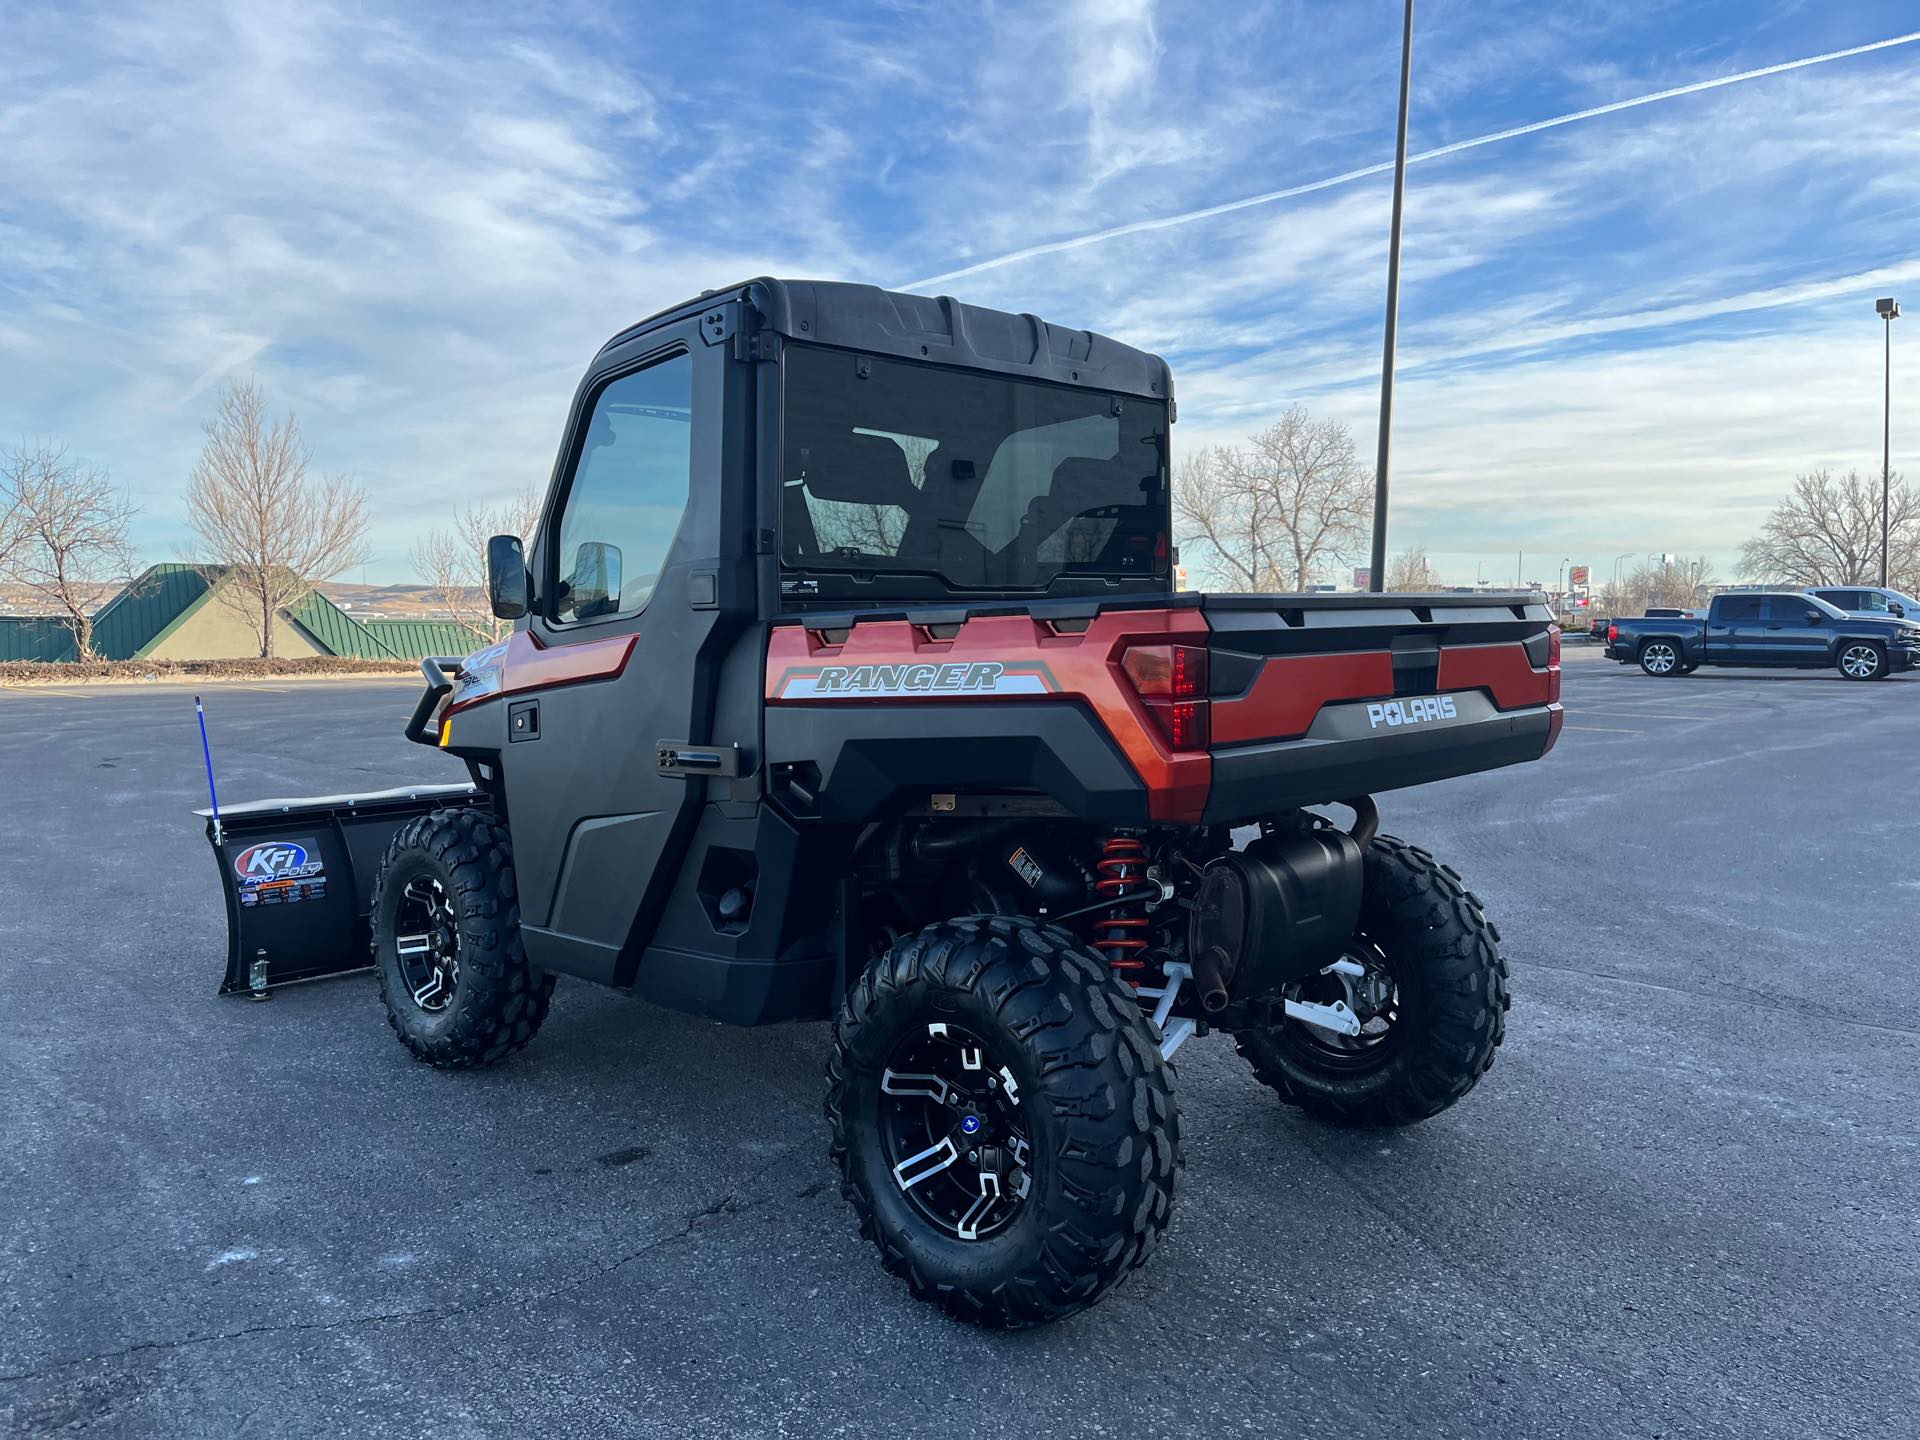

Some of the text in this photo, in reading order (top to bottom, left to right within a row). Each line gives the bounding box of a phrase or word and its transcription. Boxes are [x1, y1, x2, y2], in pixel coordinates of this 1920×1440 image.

[815, 662, 1003, 692] RANGER
[1366, 696, 1457, 729] POLARIS
[244, 864, 321, 885] PRO POLY
